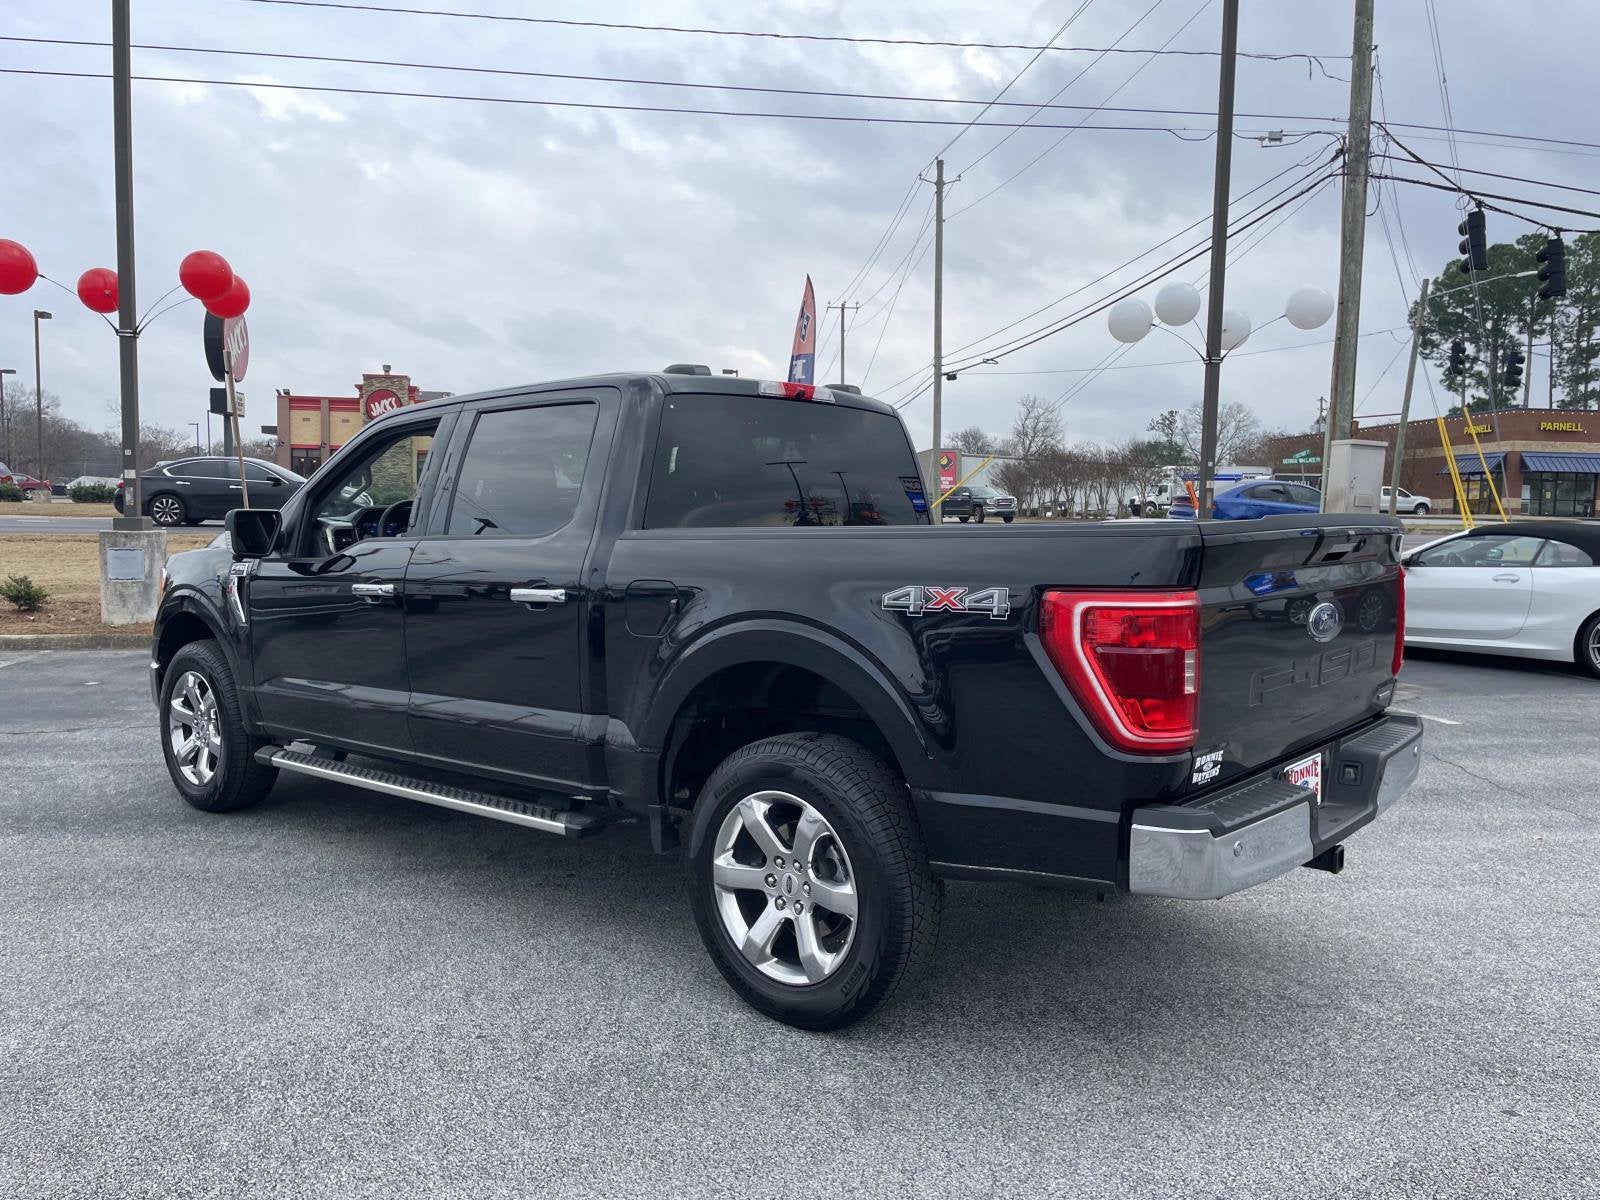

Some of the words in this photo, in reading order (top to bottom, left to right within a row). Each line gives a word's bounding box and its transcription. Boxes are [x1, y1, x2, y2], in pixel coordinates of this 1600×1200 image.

[1540, 422, 1584, 432] PARNELL
[1249, 638, 1377, 708] F-150
[1194, 749, 1224, 770] RONNIE
[1191, 764, 1221, 784] WATKINS
[1288, 759, 1319, 785] RONNIE
